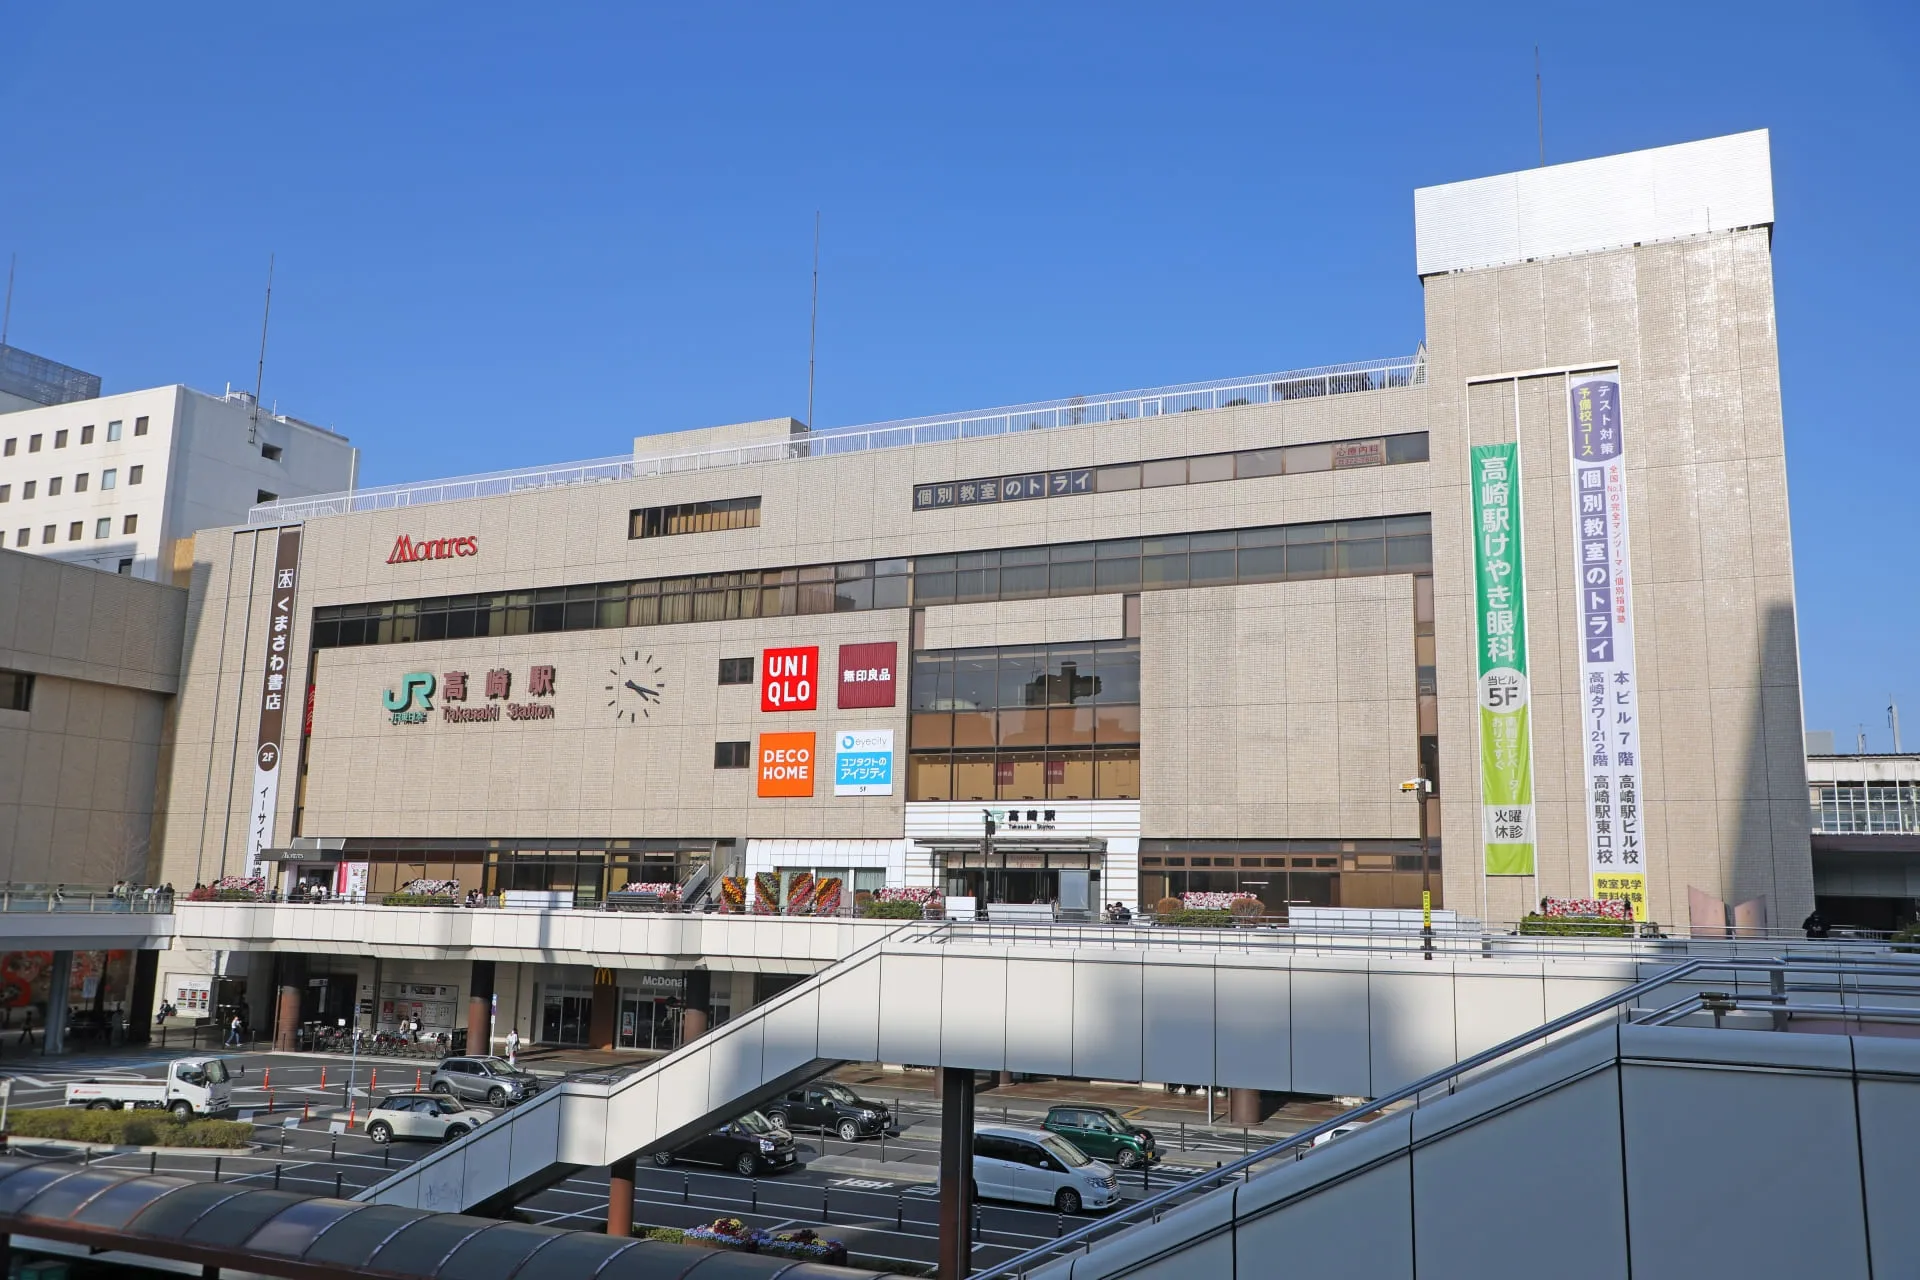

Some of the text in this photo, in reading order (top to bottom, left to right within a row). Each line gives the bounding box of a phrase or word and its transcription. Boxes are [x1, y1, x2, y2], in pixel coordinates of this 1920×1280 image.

[1579, 388, 1593, 456] 予備校コース
[1598, 385, 1614, 455] テスト対策
[917, 473, 1089, 505] 個別教室のトライ
[386, 534, 478, 564] Montres
[1481, 457, 1515, 663] 高崎駅けやき眼科
[1581, 470, 1608, 660] 個別教室のトライ
[265, 597, 290, 710] くまざわ書店
[769, 655, 807, 677] UNI
[843, 668, 891, 682] 無印良品
[384, 665, 556, 711] JR 高崎駅
[1487, 675, 1517, 686] 当ビル
[768, 680, 810, 706] QLO
[1489, 687, 1518, 707] 5F
[441, 703, 555, 723] Takasaki Station
[856, 737, 887, 748] eyecity
[262, 752, 275, 762] 2F
[764, 749, 809, 763] DECO
[841, 757, 887, 767] コンタクトの
[763, 766, 808, 780] HOME
[841, 767, 886, 780] アイシティ
[1614, 671, 1638, 864] 本ビル7階 高崎駅ビル校
[1495, 809, 1522, 823] 火曜
[1594, 775, 1613, 864] 高崎駅東口校
[1495, 826, 1523, 839] 休診
[1597, 879, 1642, 889] 教室見学
